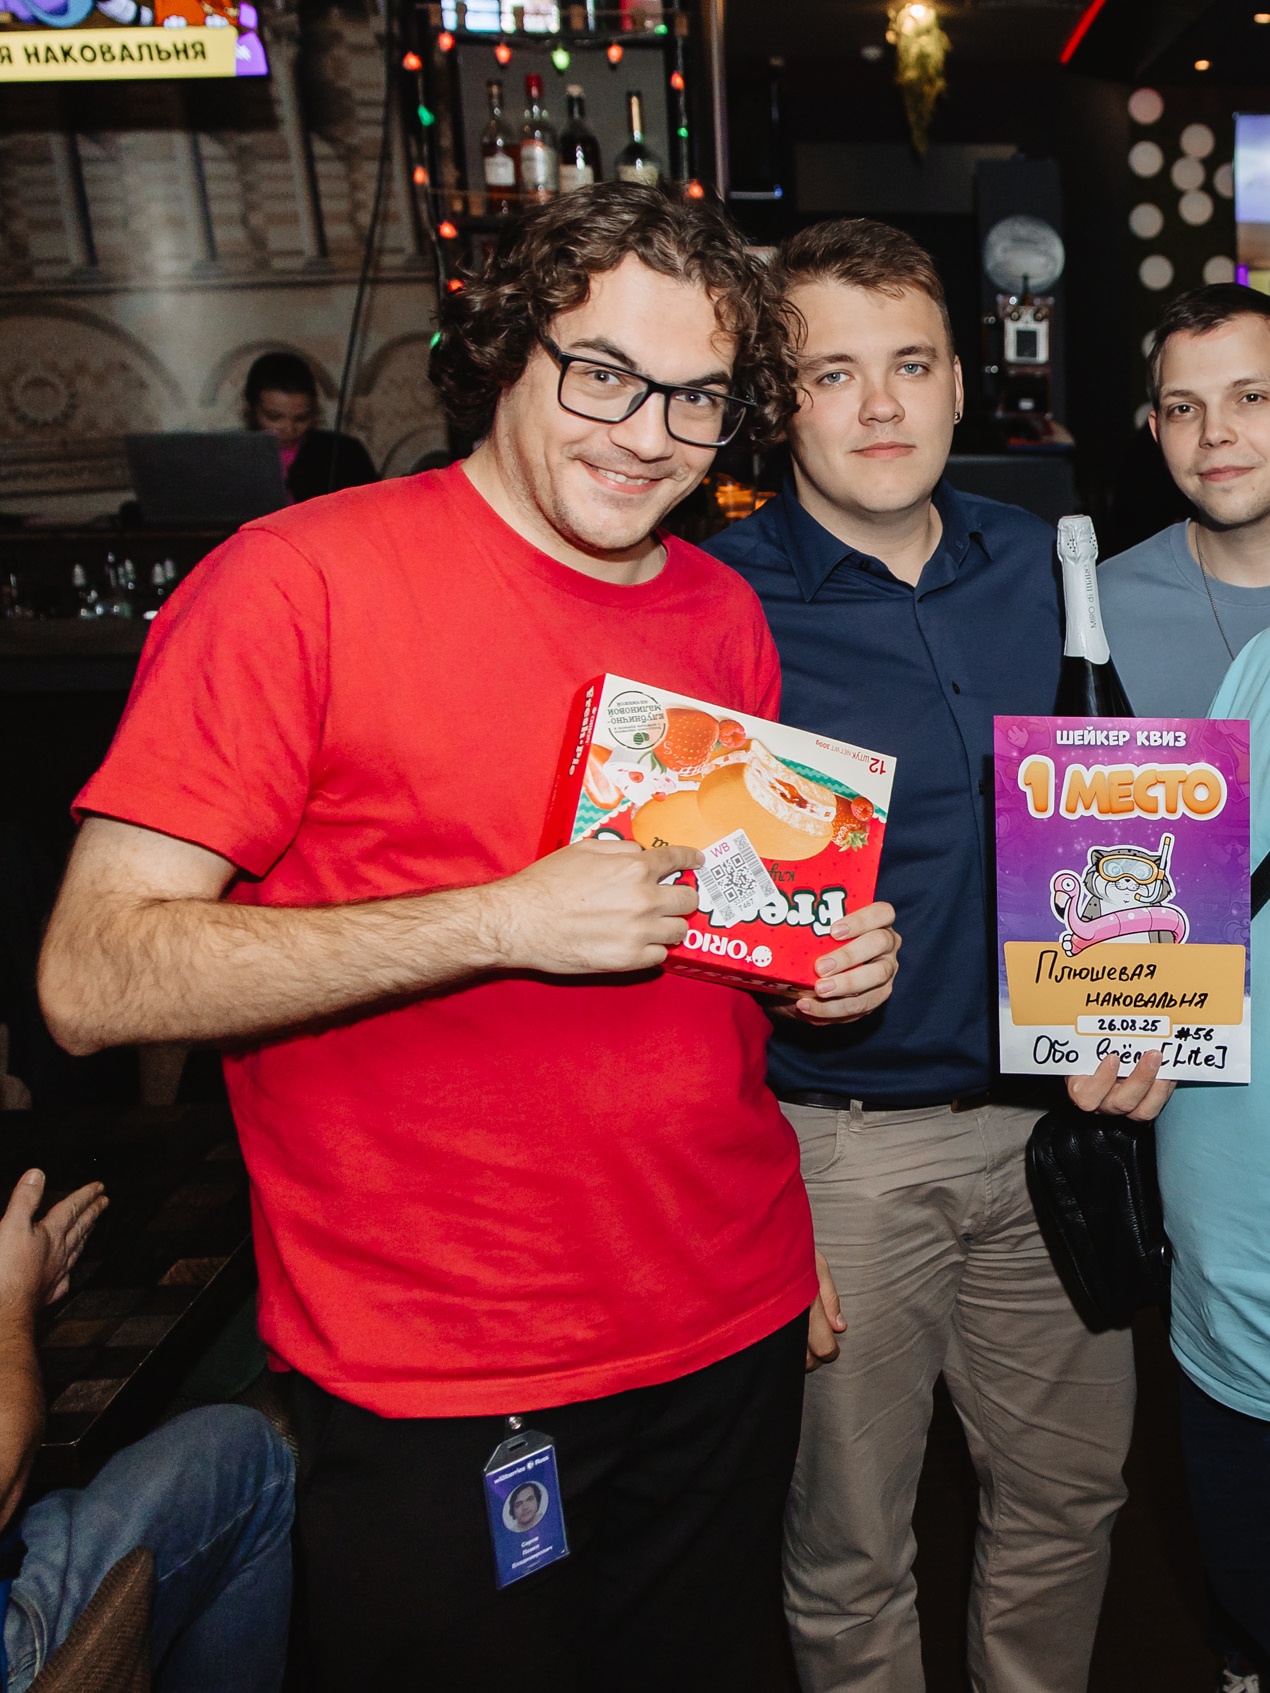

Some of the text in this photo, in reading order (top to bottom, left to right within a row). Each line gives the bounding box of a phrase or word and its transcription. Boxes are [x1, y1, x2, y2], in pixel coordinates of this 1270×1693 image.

[24, 41, 207, 64] НАКОВАЛЬНЯ
[1087, 593, 1095, 603] di
[1088, 606, 1096, 629] MIRO
[607, 704, 662, 717] малиновой
[1056, 726, 1187, 747] ШЕЙКЕР КВИЗ
[831, 745, 841, 753] WT
[840, 748, 852, 757] NET
[869, 757, 886, 775] 12
[1021, 757, 1225, 818] 1 МЕСТО
[711, 842, 730, 858] WB
[740, 898, 755, 912] 7467
[683, 929, 748, 959] ORIO
[1035, 949, 1157, 984] Плюшевая
[1085, 991, 1209, 1009] наковальня
[1097, 1018, 1162, 1033] 26.08.25
[1174, 1027, 1215, 1042] #56
[1033, 1034, 1080, 1065] Обо
[1160, 1041, 1228, 1070] [Lite]
